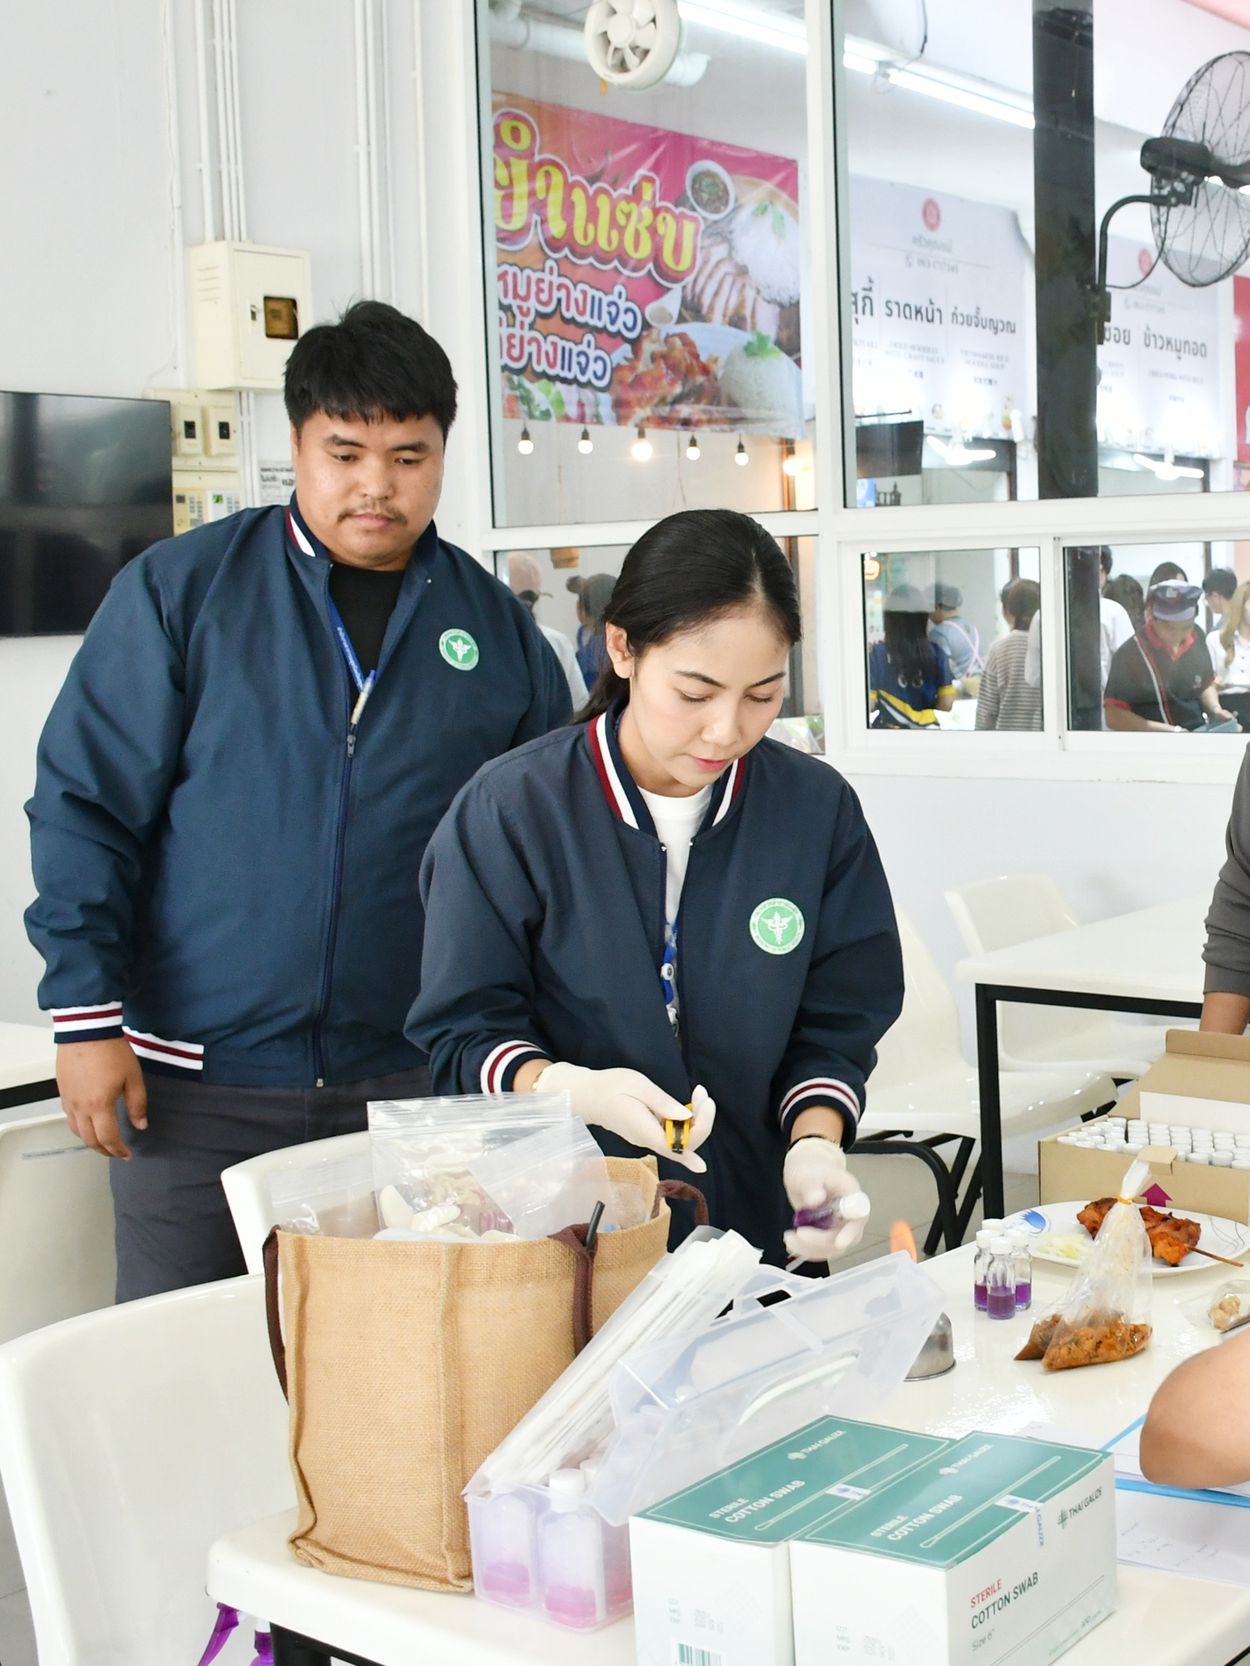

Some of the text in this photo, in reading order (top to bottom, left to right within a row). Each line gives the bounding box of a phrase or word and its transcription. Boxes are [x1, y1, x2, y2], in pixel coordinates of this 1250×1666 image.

[885, 298, 943, 325] ราดหน้า
[709, 1497, 749, 1519] STERILE
[725, 1480, 806, 1523] COTTON SWAB
[887, 1494, 963, 1540] COTTON SWAB
[1068, 1485, 1103, 1519] THAI GAUZE
[870, 1515, 909, 1537] STERILE
[970, 1578, 1003, 1609] STERILE
[971, 1571, 1039, 1630] COTTON SWAB
